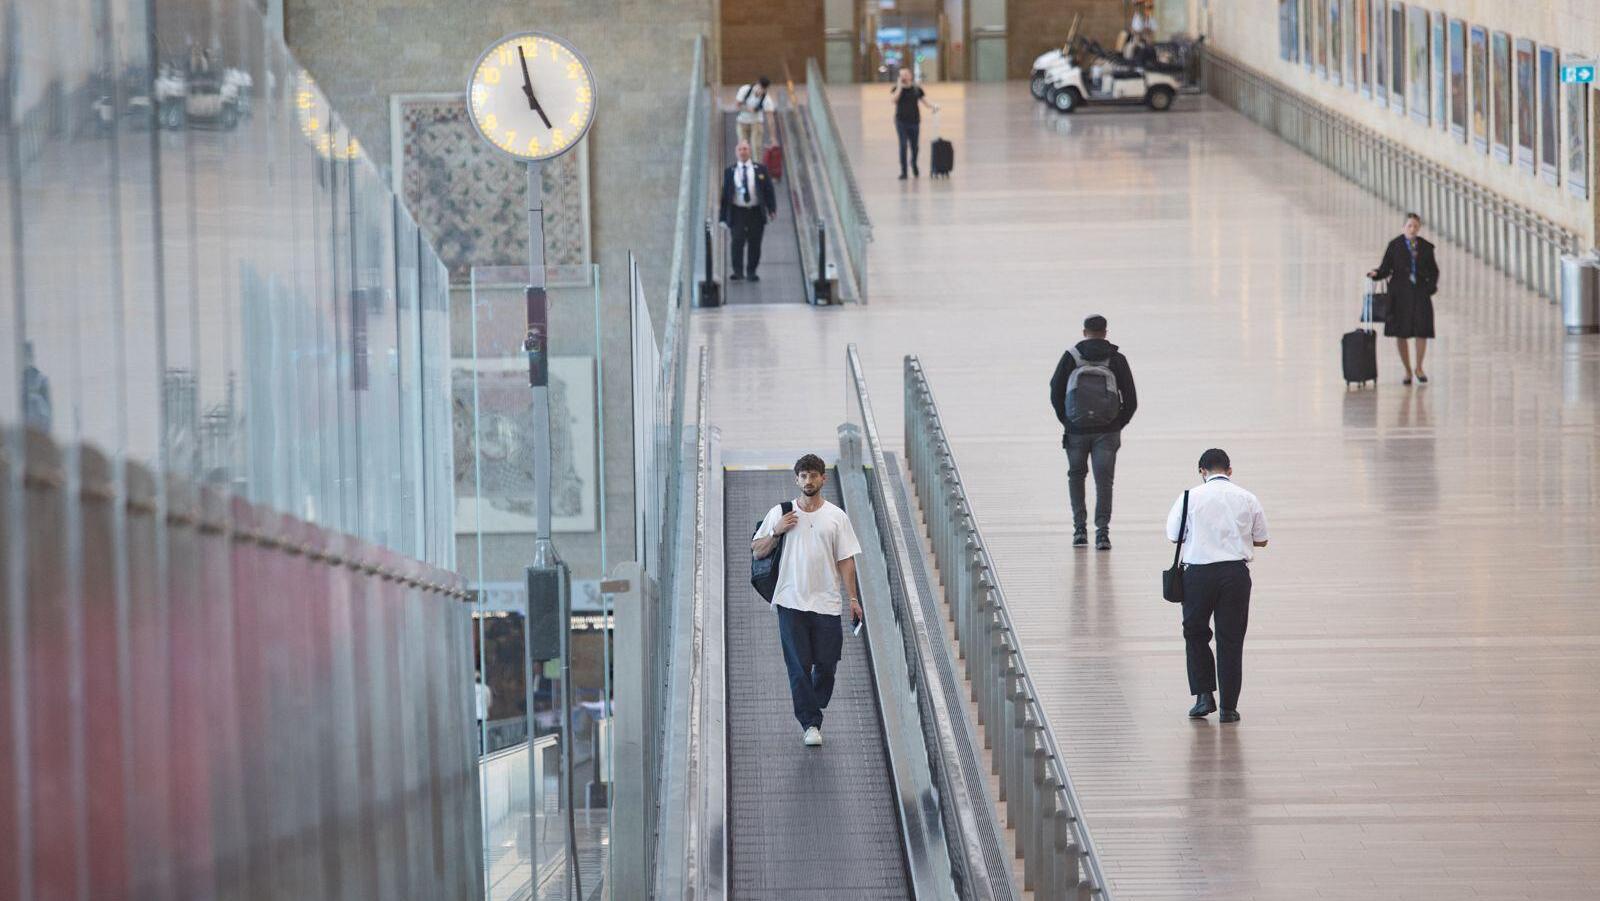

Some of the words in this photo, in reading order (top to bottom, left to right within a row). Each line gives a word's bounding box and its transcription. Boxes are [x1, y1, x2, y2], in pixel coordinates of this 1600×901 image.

[498, 46, 513, 65] 11
[523, 39, 538, 57] 12
[551, 44, 560, 63] 1
[484, 66, 500, 84] 10
[567, 63, 579, 80] 2
[576, 88, 589, 103] 3
[485, 114, 497, 129] 8
[568, 112, 579, 127] 4
[505, 130, 517, 145] 7
[528, 137, 540, 153] 6
[552, 128, 564, 146] 5
